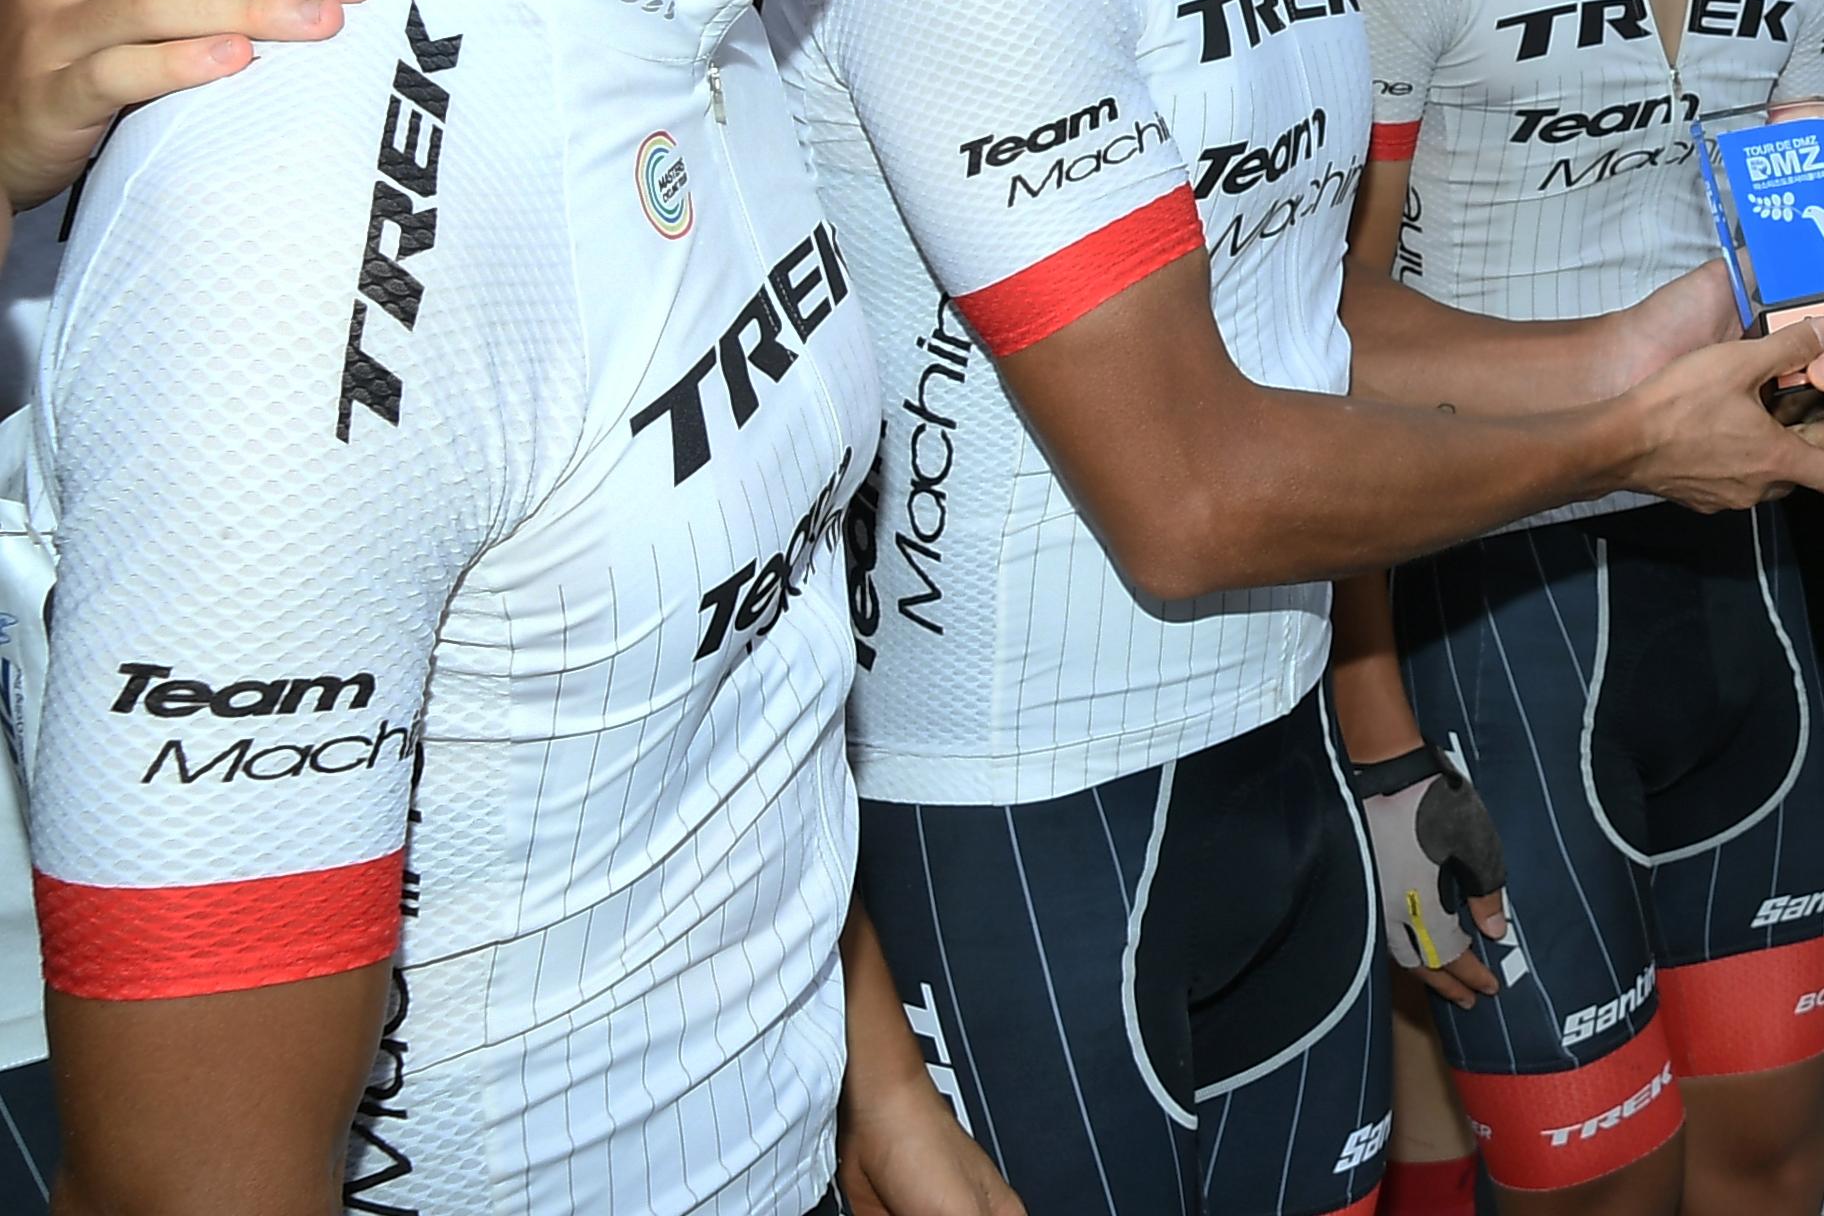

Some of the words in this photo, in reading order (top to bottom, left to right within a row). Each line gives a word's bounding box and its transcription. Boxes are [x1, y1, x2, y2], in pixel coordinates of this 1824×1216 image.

[959, 96, 1119, 178] Team
[1195, 107, 1327, 200] Team
[1510, 92, 1700, 144] Team
[110, 663, 376, 718] Team
[1541, 1060, 1673, 1146] TREK
